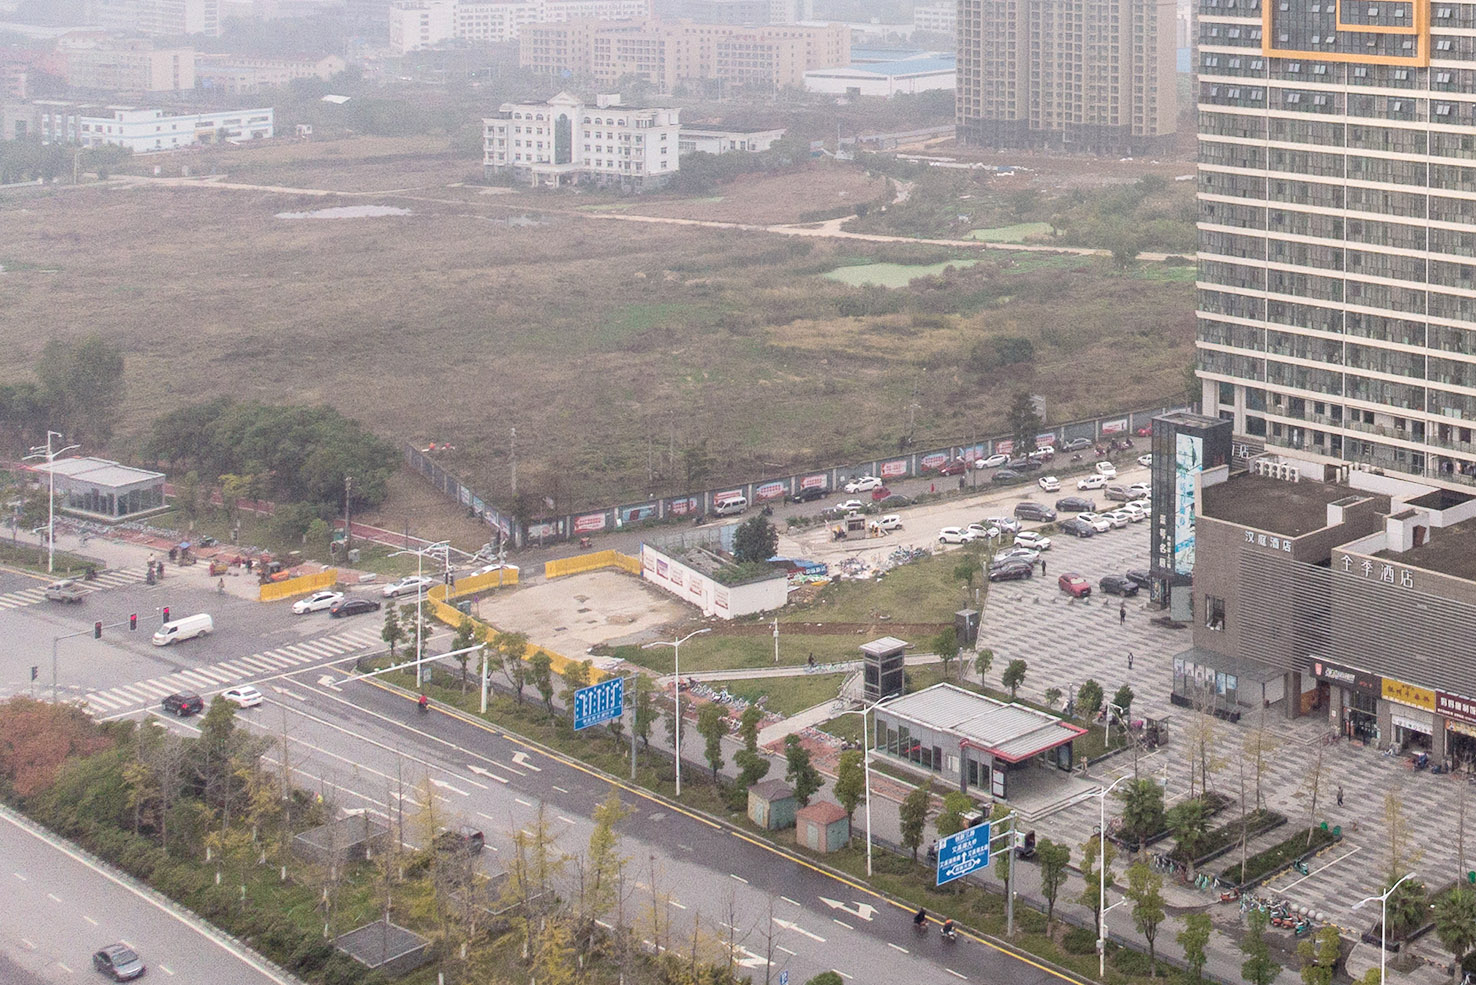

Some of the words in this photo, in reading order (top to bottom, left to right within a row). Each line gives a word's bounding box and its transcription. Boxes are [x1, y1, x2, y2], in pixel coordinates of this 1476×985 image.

[1244, 530, 1292, 553] 汉庭酒店
[1341, 554, 1413, 588] 全季酒店
